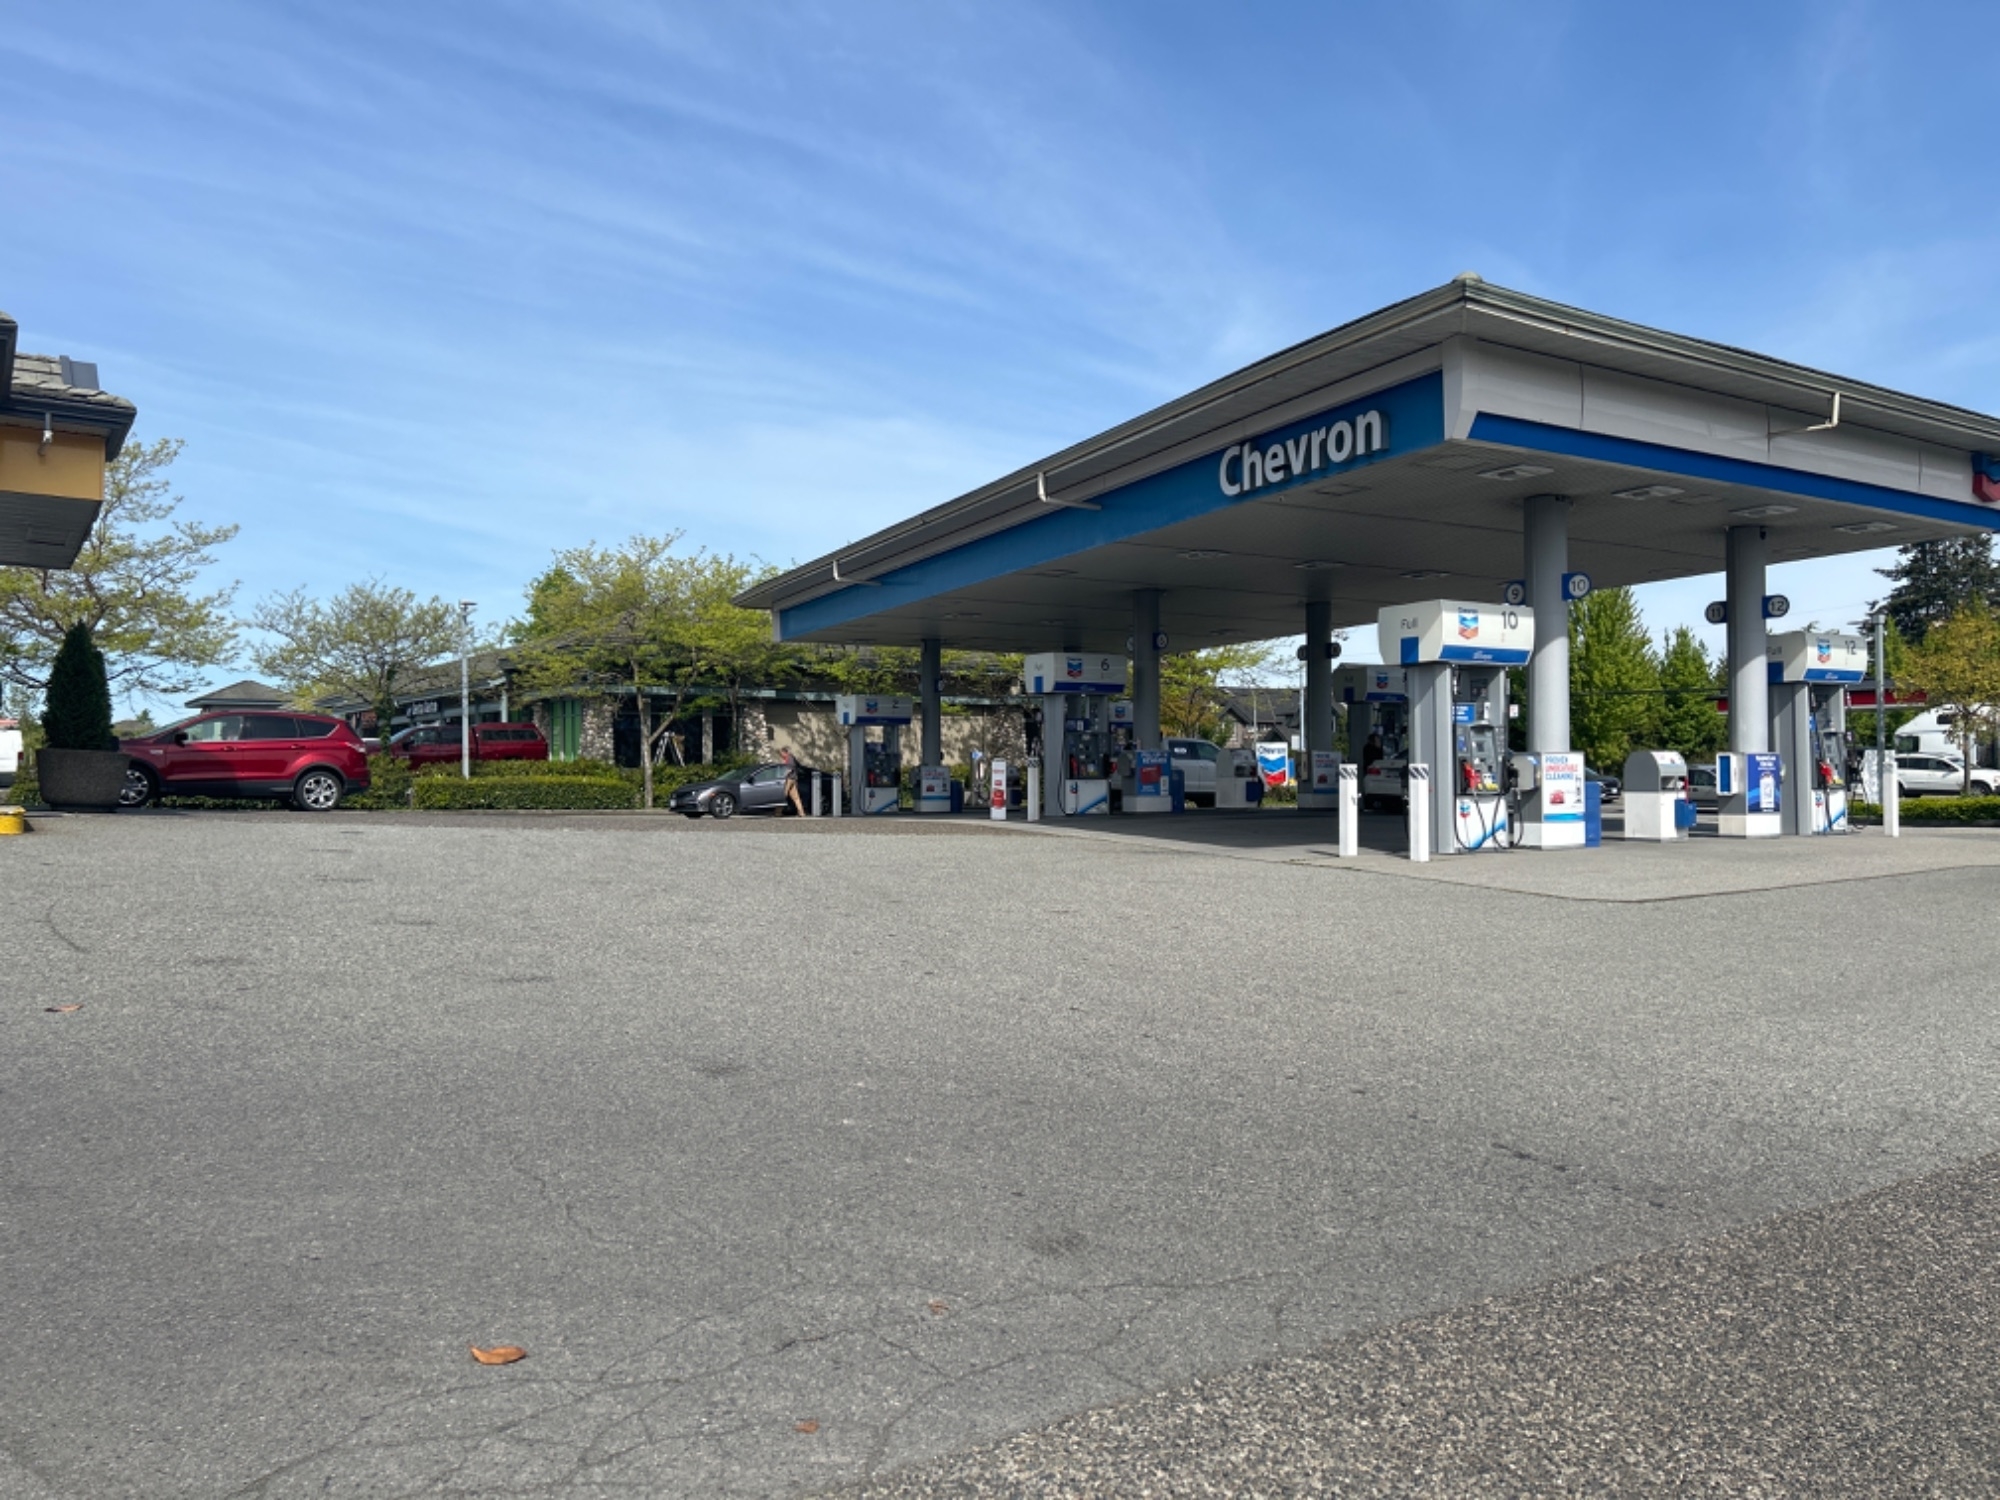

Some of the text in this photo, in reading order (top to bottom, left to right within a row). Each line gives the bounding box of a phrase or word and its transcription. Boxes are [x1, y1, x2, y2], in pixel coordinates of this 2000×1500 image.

[1219, 410, 1384, 496] Chevron
[1571, 579, 1587, 592] 10
[1511, 587, 1520, 600] 9
[1770, 600, 1785, 612] 12
[1711, 608, 1722, 619] 11
[1501, 611, 1518, 630] 10
[1844, 640, 1857, 655] 12
[1100, 658, 1110, 671] 6
[892, 699, 900, 709] 2
